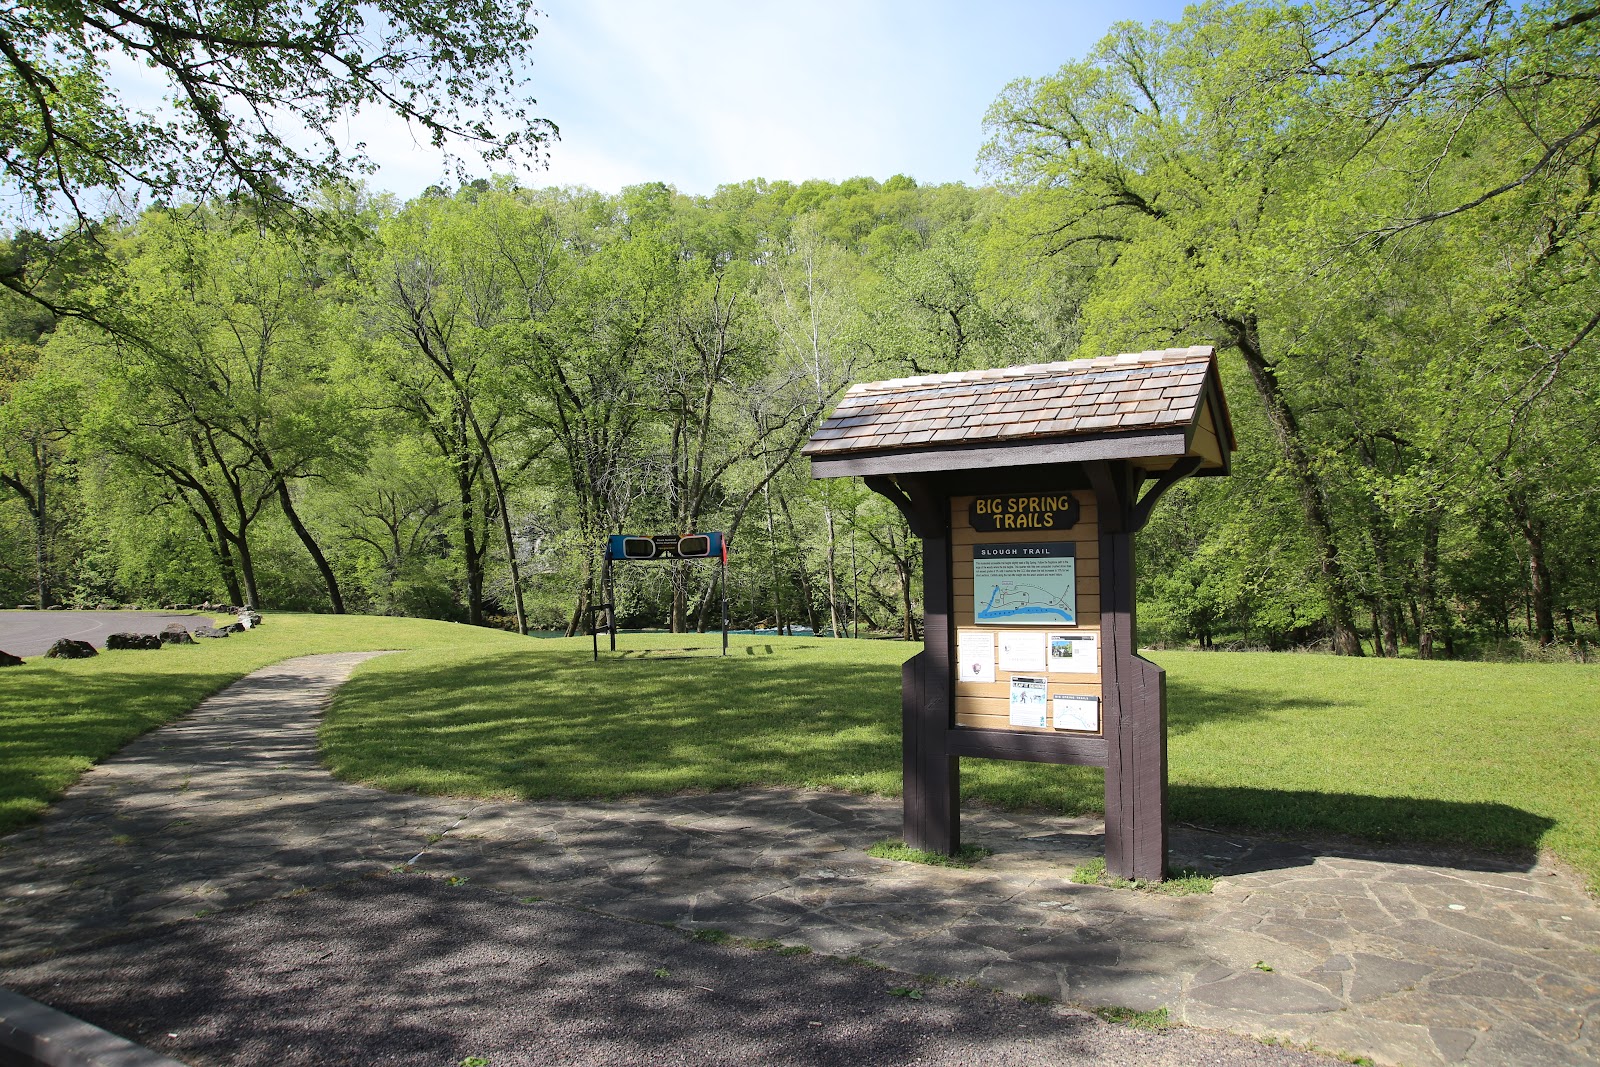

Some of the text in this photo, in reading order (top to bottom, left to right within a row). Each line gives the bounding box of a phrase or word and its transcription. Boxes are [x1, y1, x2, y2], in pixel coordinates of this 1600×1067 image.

[976, 496, 1069, 514] BIG SPRING
[993, 512, 1054, 529] TRAILS
